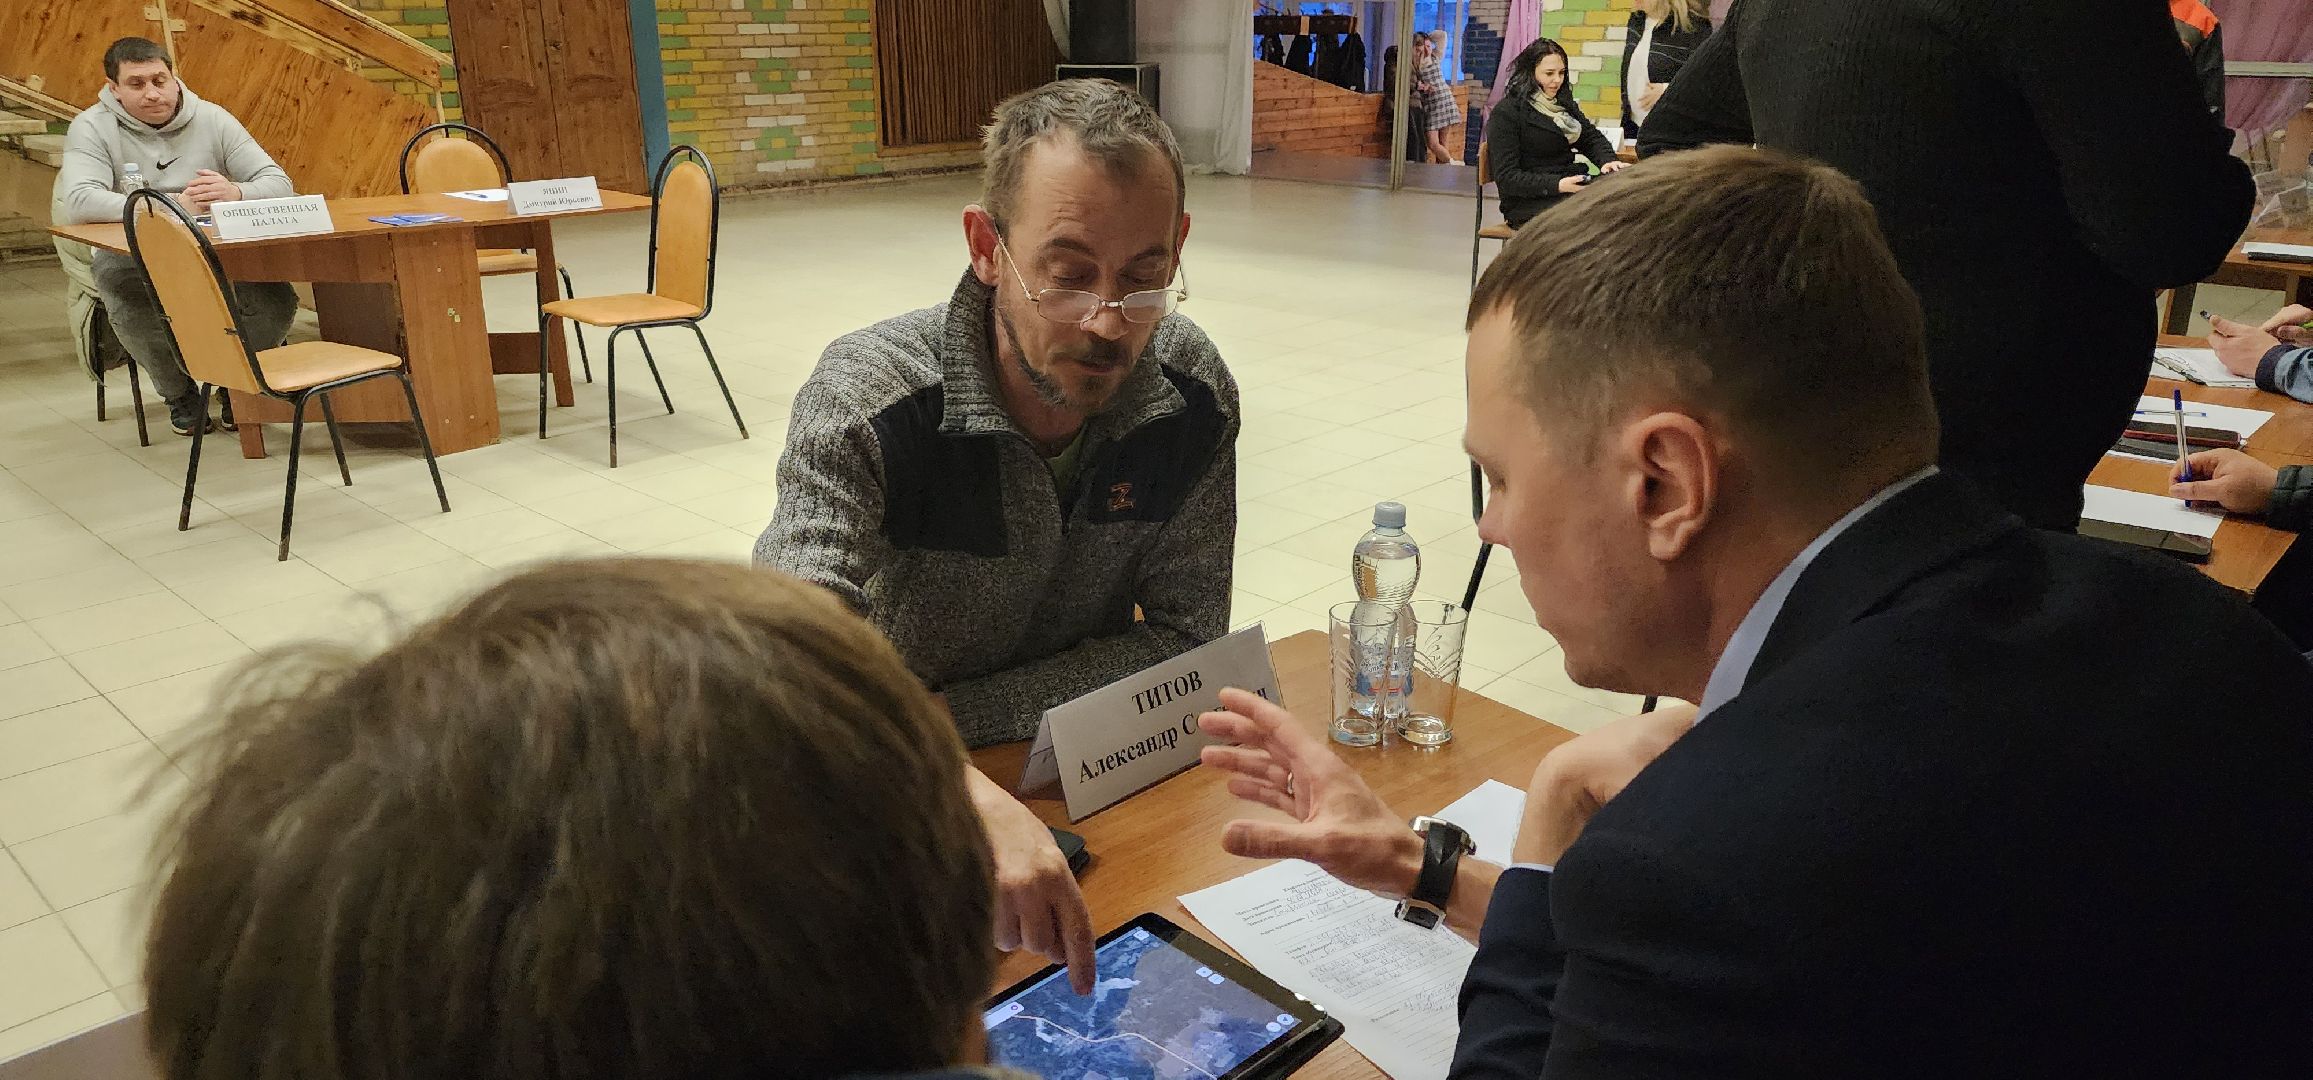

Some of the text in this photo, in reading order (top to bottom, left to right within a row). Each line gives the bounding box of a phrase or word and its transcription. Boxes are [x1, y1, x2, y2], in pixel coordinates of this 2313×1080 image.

[222, 203, 319, 218] ОБЩЕСТВЕННАЯ
[251, 216, 300, 227] ПАЛАТА
[1131, 670, 1202, 715] ТИТОВ
[1079, 726, 1178, 784] Александр
